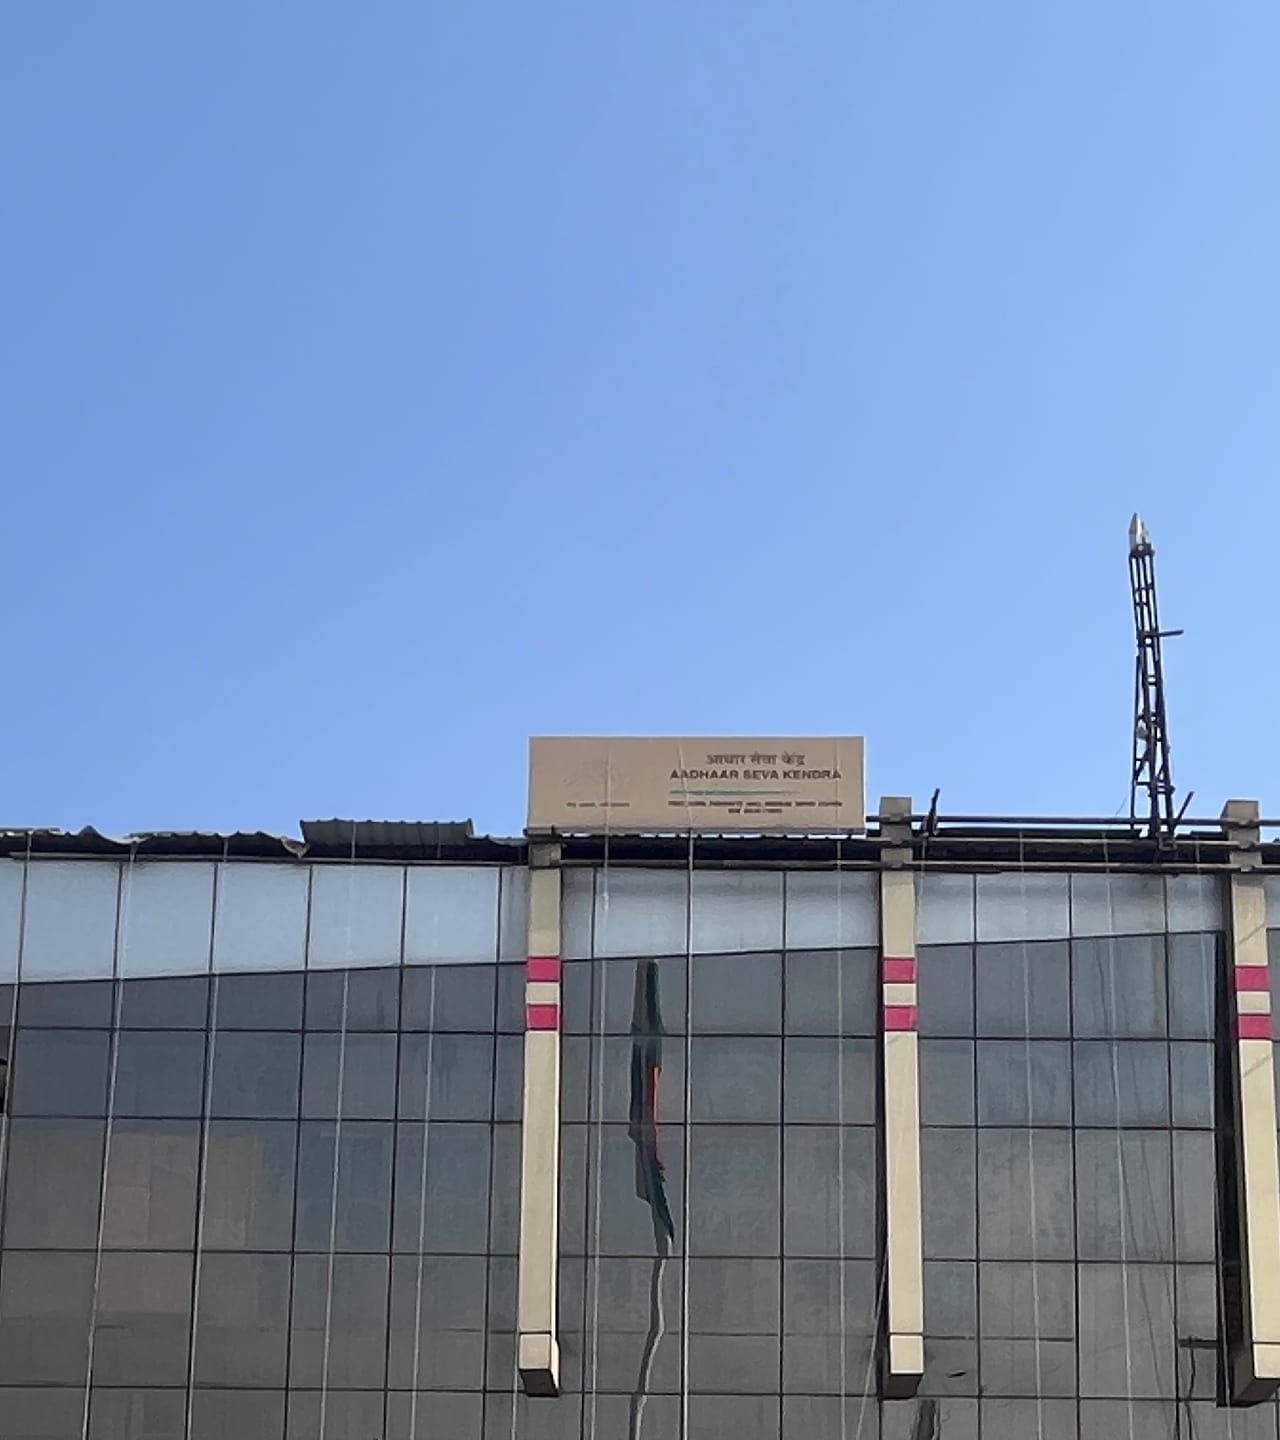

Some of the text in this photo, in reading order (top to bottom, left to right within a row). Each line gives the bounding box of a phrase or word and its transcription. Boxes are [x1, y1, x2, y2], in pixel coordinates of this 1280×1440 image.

[669, 769, 842, 780] AADHAAR SEVA KENDRA
